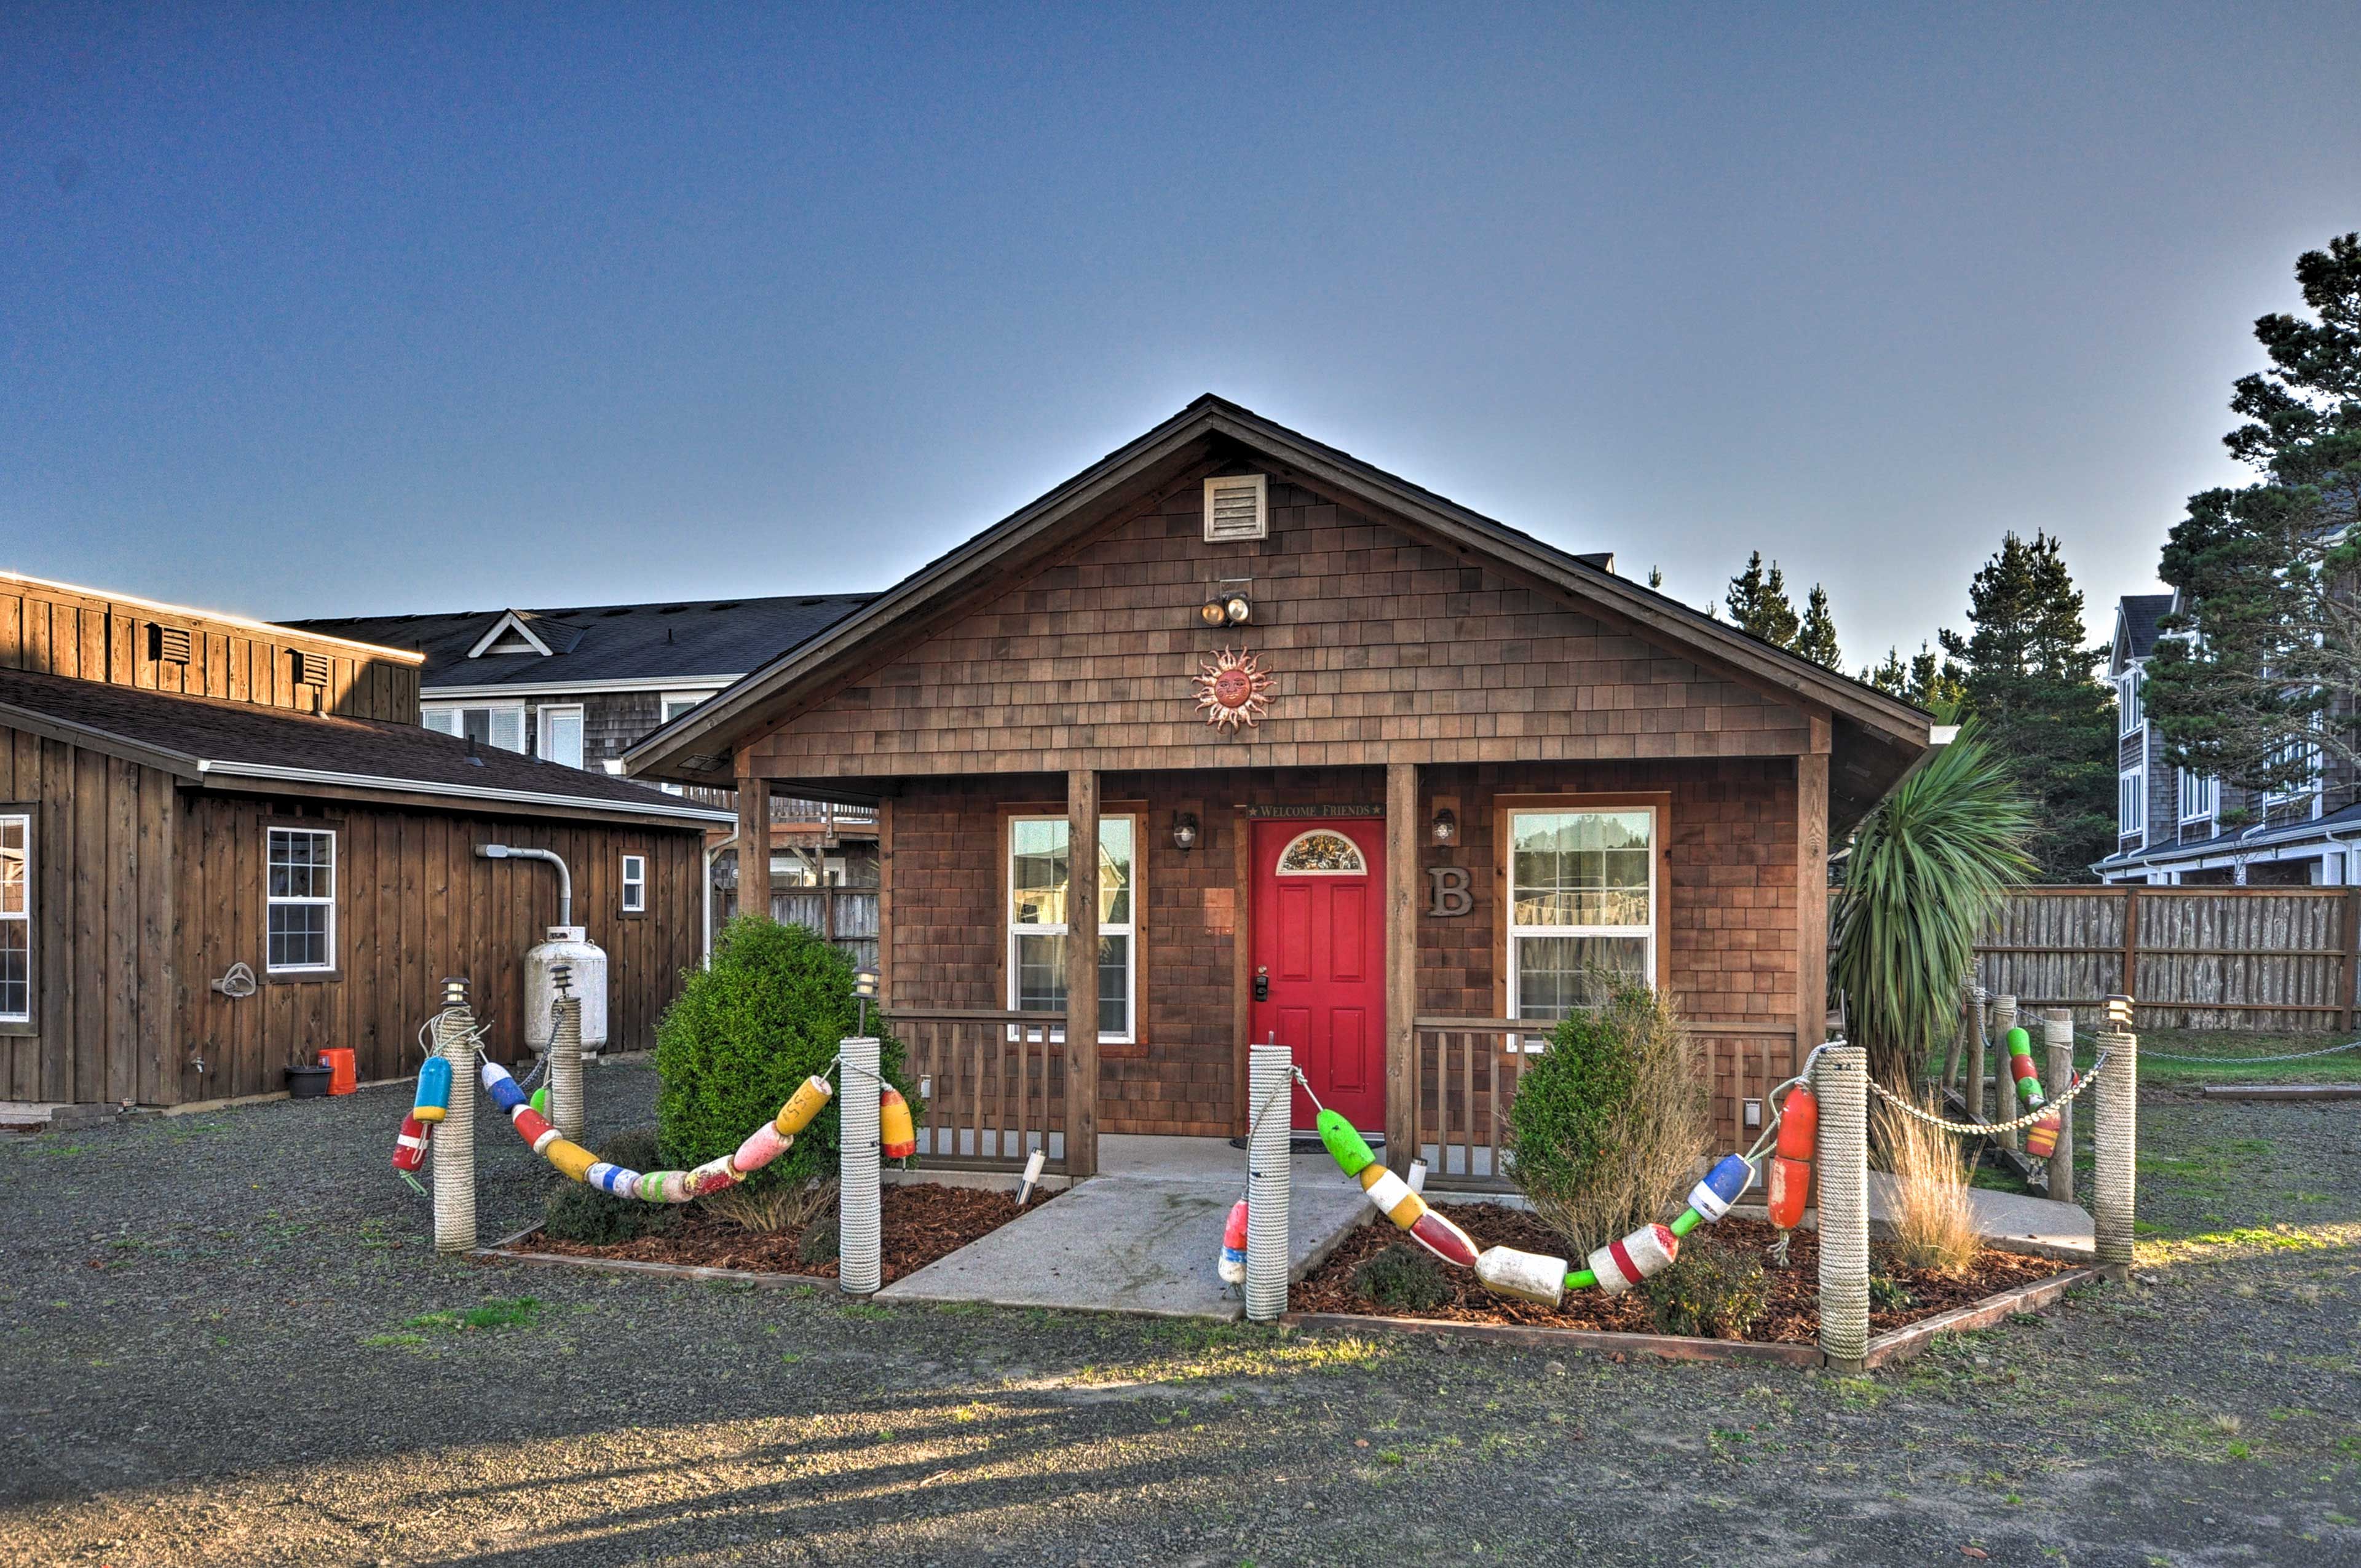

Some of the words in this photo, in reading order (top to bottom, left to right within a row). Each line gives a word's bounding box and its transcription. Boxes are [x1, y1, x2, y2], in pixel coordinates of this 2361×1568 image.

[1260, 806, 1316, 817] WELCOME
[1323, 804, 1370, 816] FRIENDS
[1426, 866, 1473, 917] B
